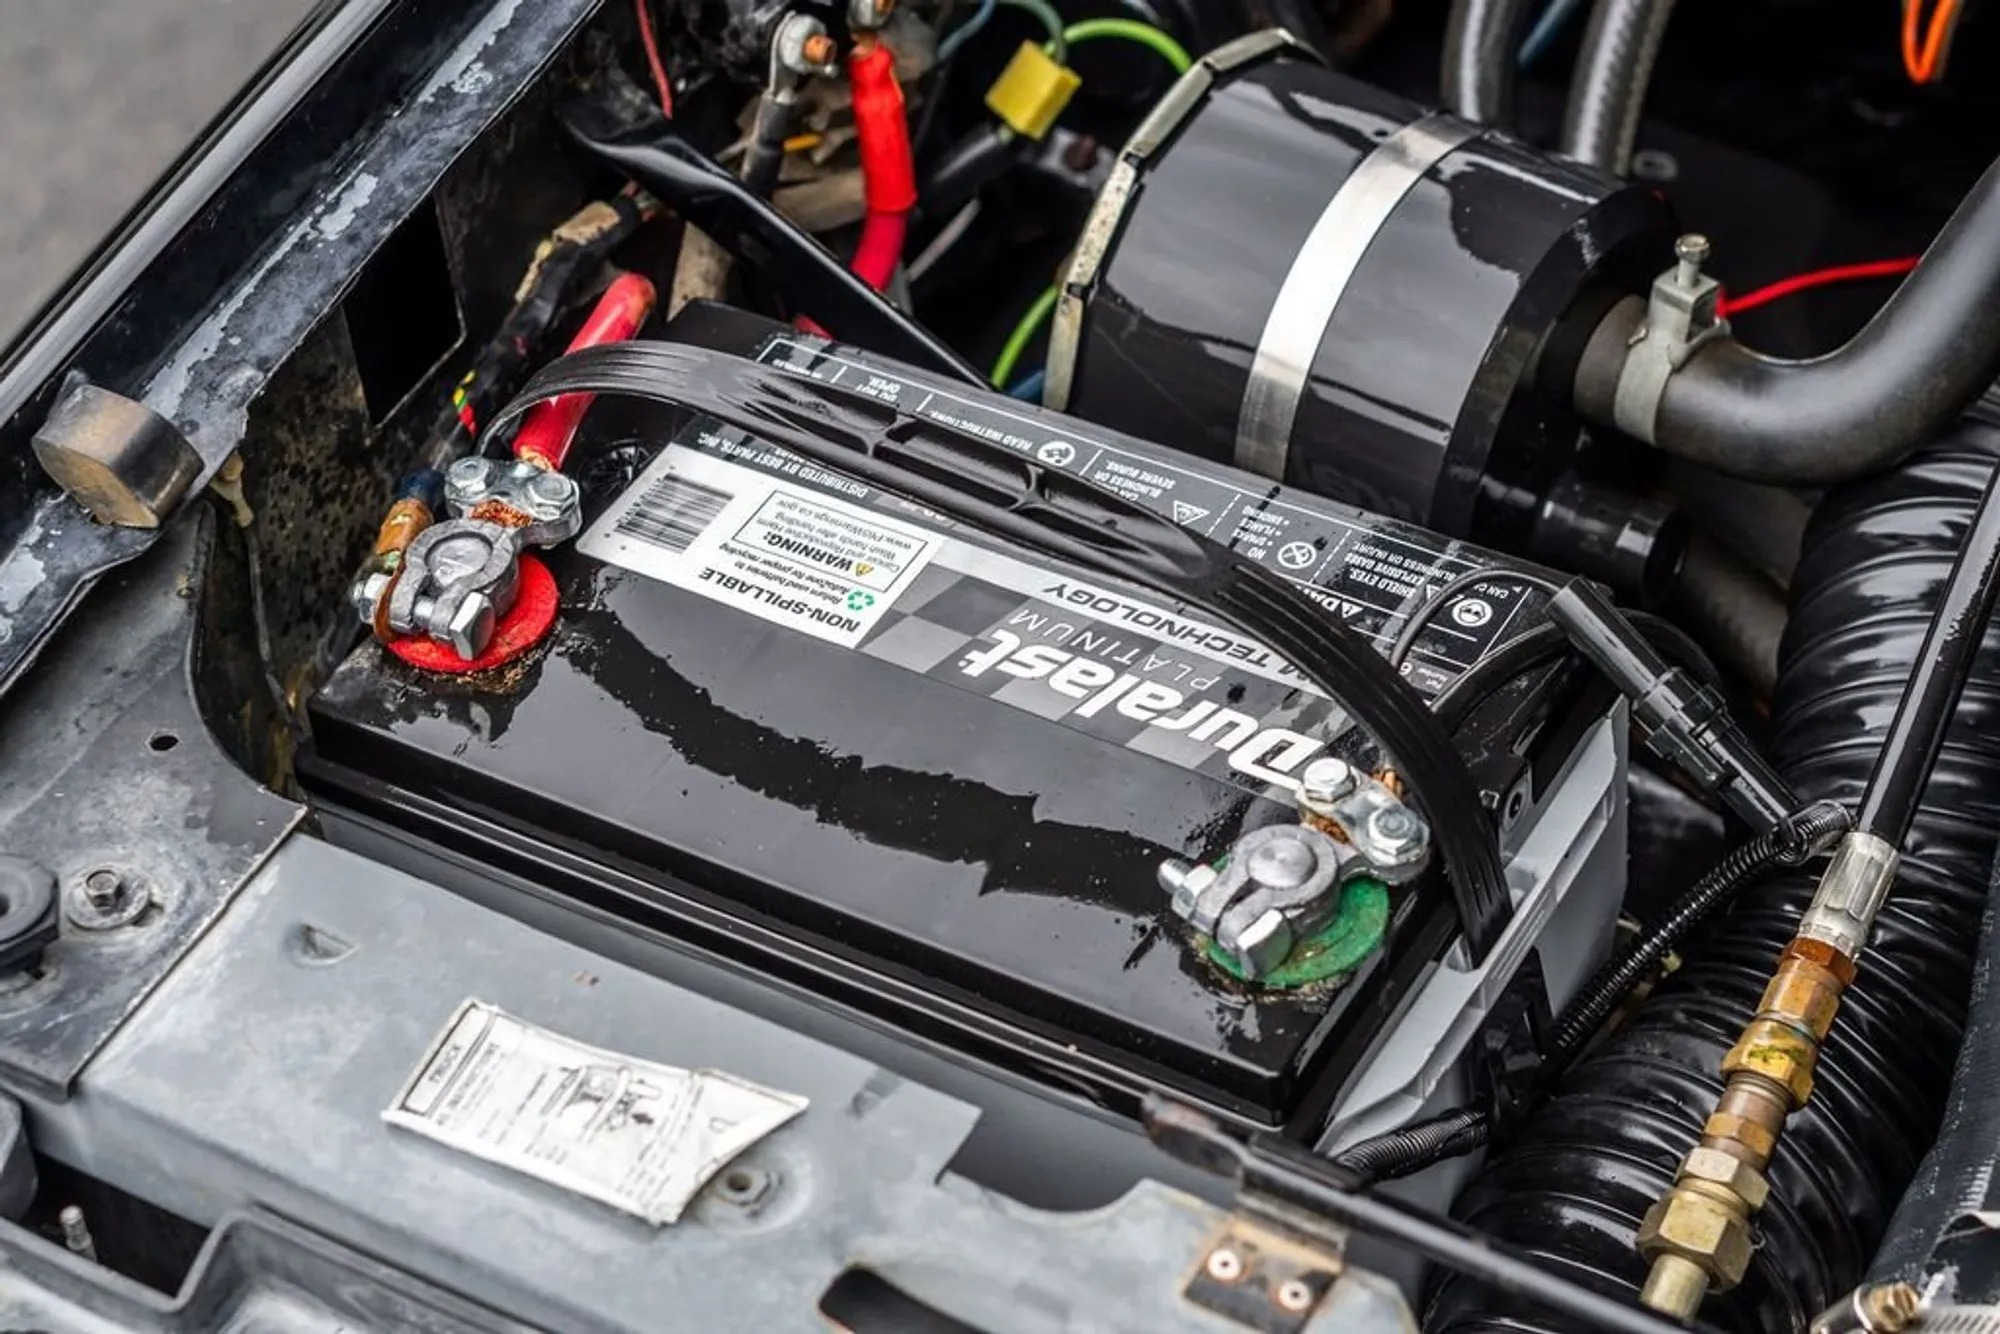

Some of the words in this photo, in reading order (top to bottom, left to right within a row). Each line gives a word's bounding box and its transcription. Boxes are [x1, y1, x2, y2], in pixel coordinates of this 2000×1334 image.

[1001, 434, 1034, 450] READ
[753, 451, 786, 468] BEST
[781, 460, 801, 473] BY
[796, 465, 870, 497] DISTRIBUTED
[1092, 469, 1111, 481] OR
[1136, 470, 1177, 490] SEVERE
[1107, 474, 1163, 498] BLINDNESS
[813, 526, 840, 540] after
[1237, 516, 1276, 535] FLAMES
[782, 526, 846, 554] Reproductive
[835, 534, 869, 550] hands
[716, 541, 762, 563] recycling
[760, 531, 855, 570] WARNING:
[841, 546, 866, 560] and
[864, 544, 898, 560] Wash
[1245, 545, 1268, 559] NO
[1342, 551, 1377, 569] GASES
[1385, 552, 1405, 564] OR
[732, 560, 752, 571] to
[757, 555, 794, 574] proper
[862, 554, 902, 572] Cancer
[1401, 557, 1457, 581] BLINDNESS
[748, 566, 789, 585] batteries
[787, 568, 806, 580] for
[1371, 561, 1426, 586] EXPLOSIVE
[784, 578, 812, 594] used
[801, 573, 851, 596] AutoZone
[1374, 577, 1417, 598] SHIELD
[697, 566, 862, 633] NON-SPILLABLE
[808, 587, 844, 605] Return
[1042, 576, 1274, 668] TECHNOLOGY
[1009, 609, 1224, 693] PLATINUM
[959, 628, 1326, 789] Duralast
